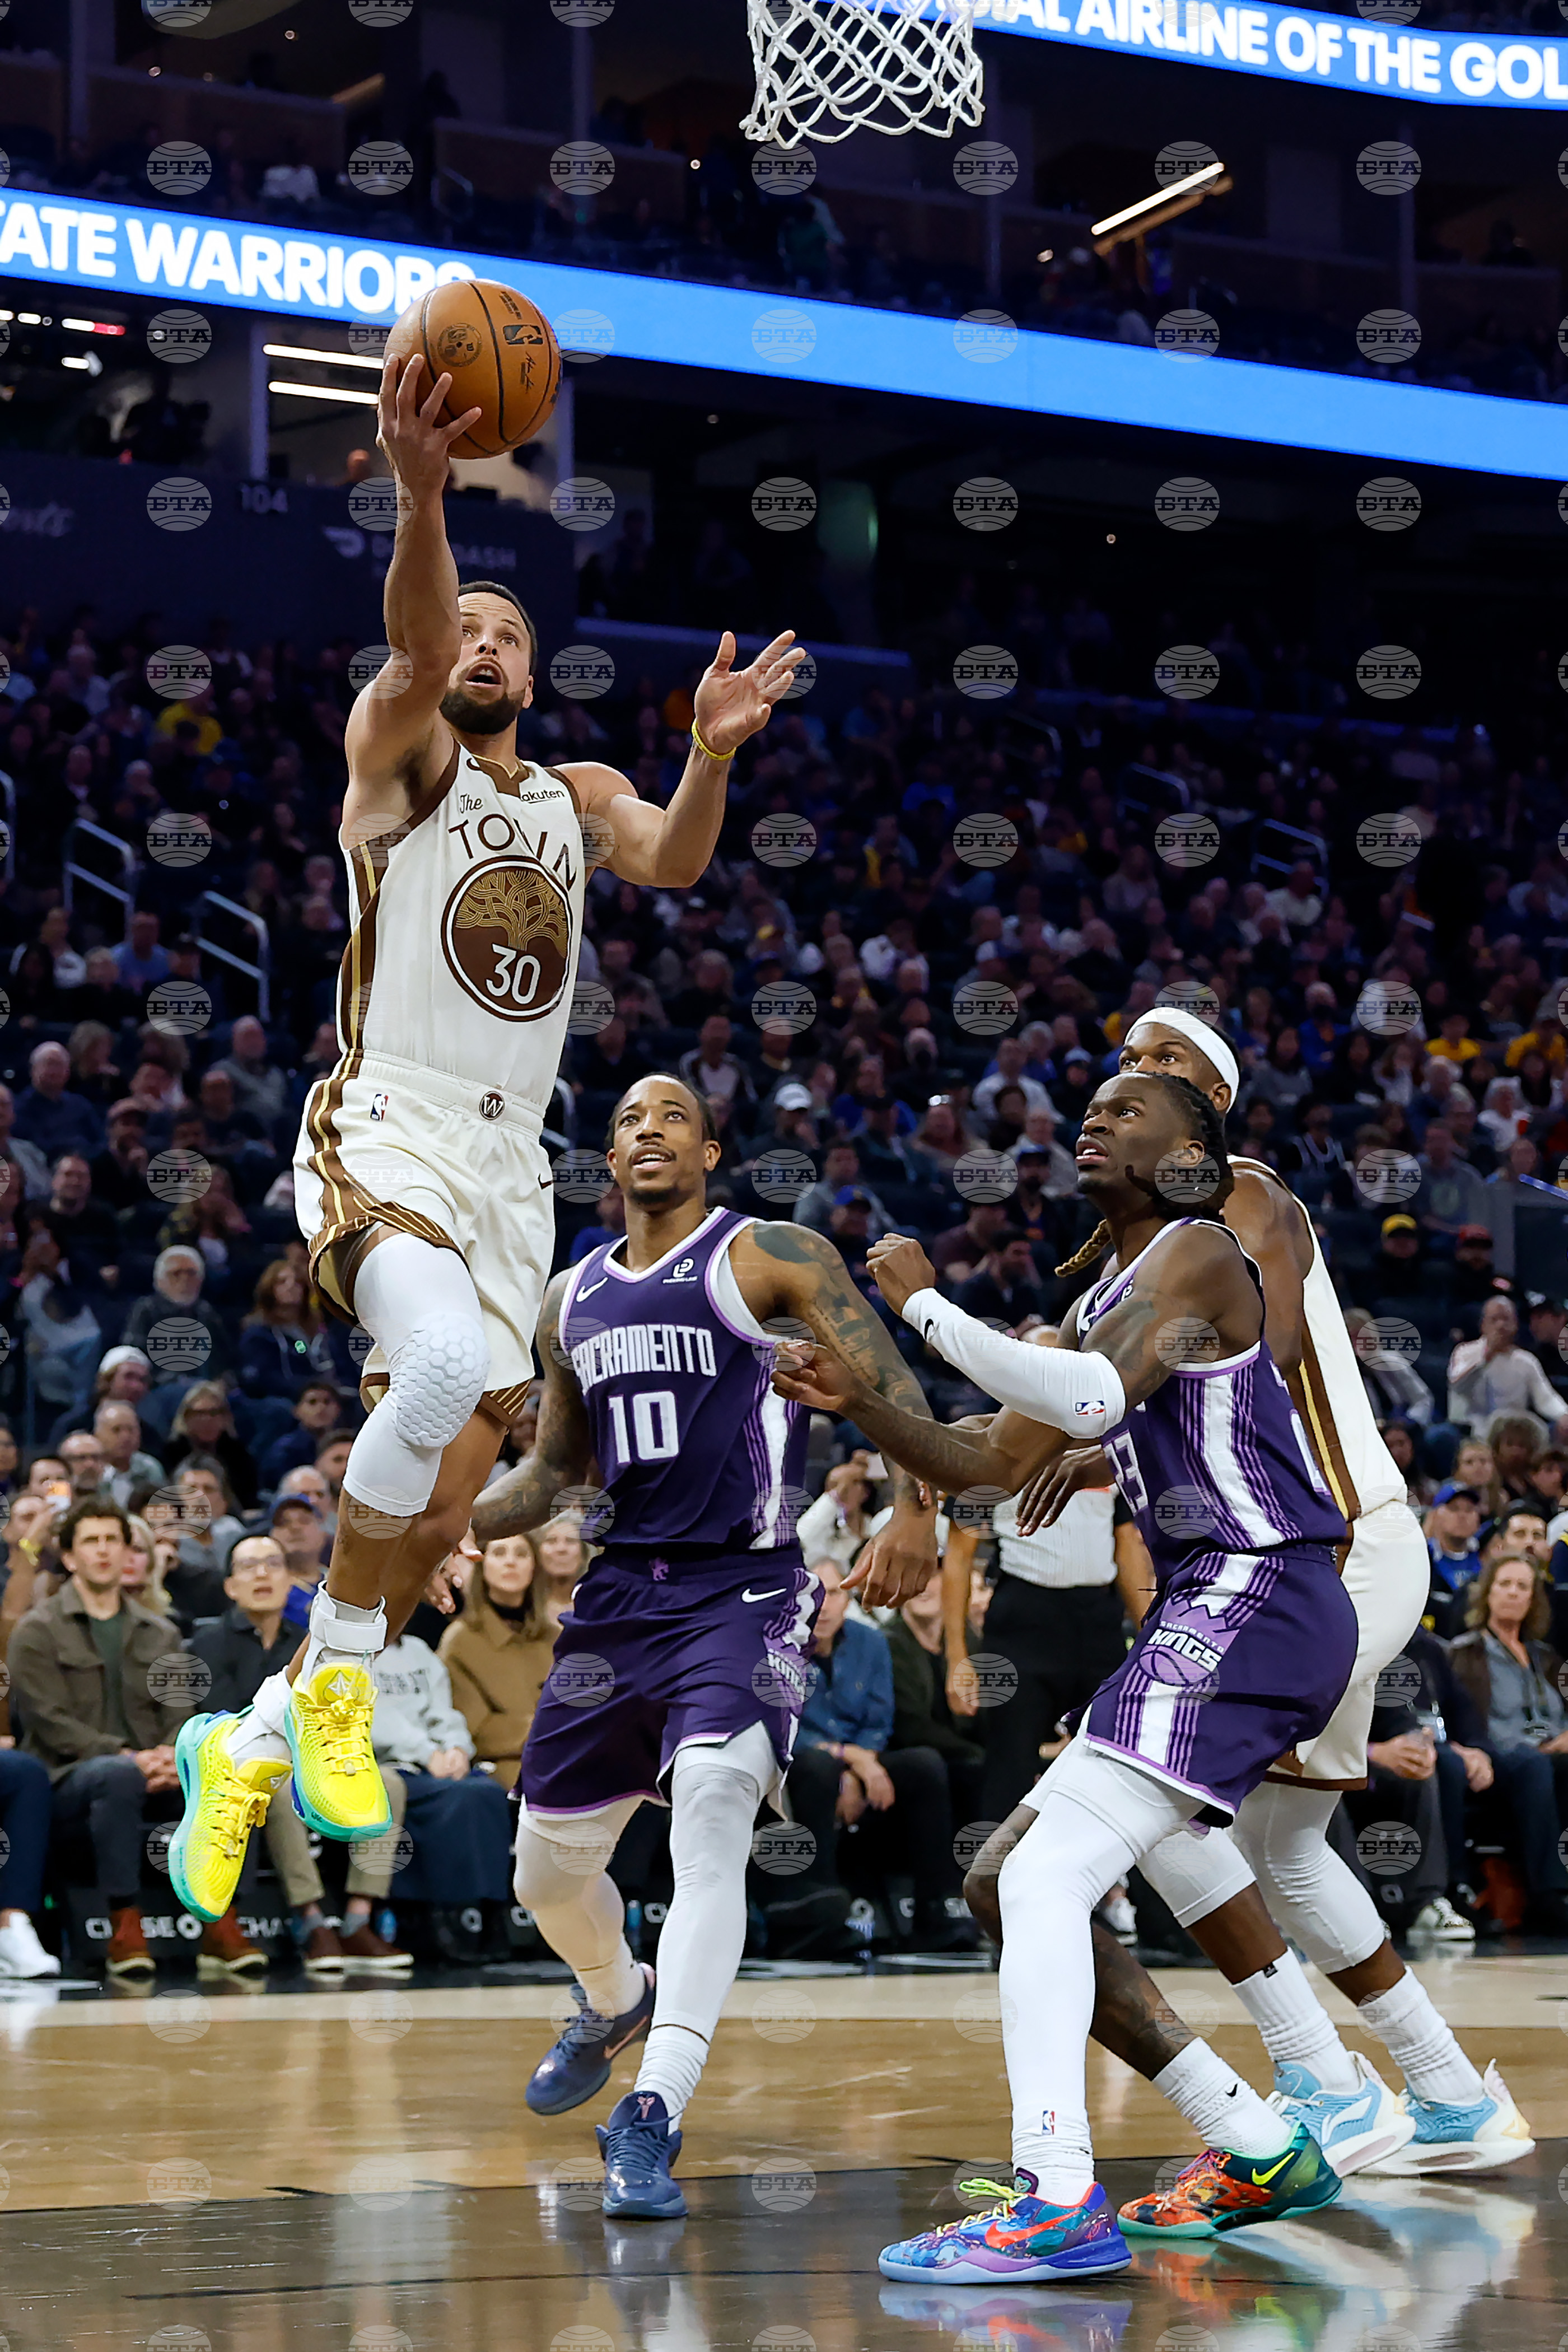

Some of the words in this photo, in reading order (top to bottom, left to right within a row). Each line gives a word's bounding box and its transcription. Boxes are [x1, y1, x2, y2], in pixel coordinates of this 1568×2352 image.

[1074, 0, 1268, 66] AIRLINE
[1275, 16, 1343, 76] OF
[1346, 27, 1441, 94] THE
[1449, 41, 1568, 100] GOL
[0, 199, 116, 278] ATE
[240, 483, 288, 514] 104
[459, 792, 483, 814] The
[520, 790, 565, 803] akuten
[486, 943, 541, 1005] 30
[571, 1324, 717, 1397] SACRAMENTO
[608, 1390, 679, 1464] 10
[1147, 1628, 1222, 1672] KINGS
[1160, 1620, 1225, 1653] SACRAMENTO
